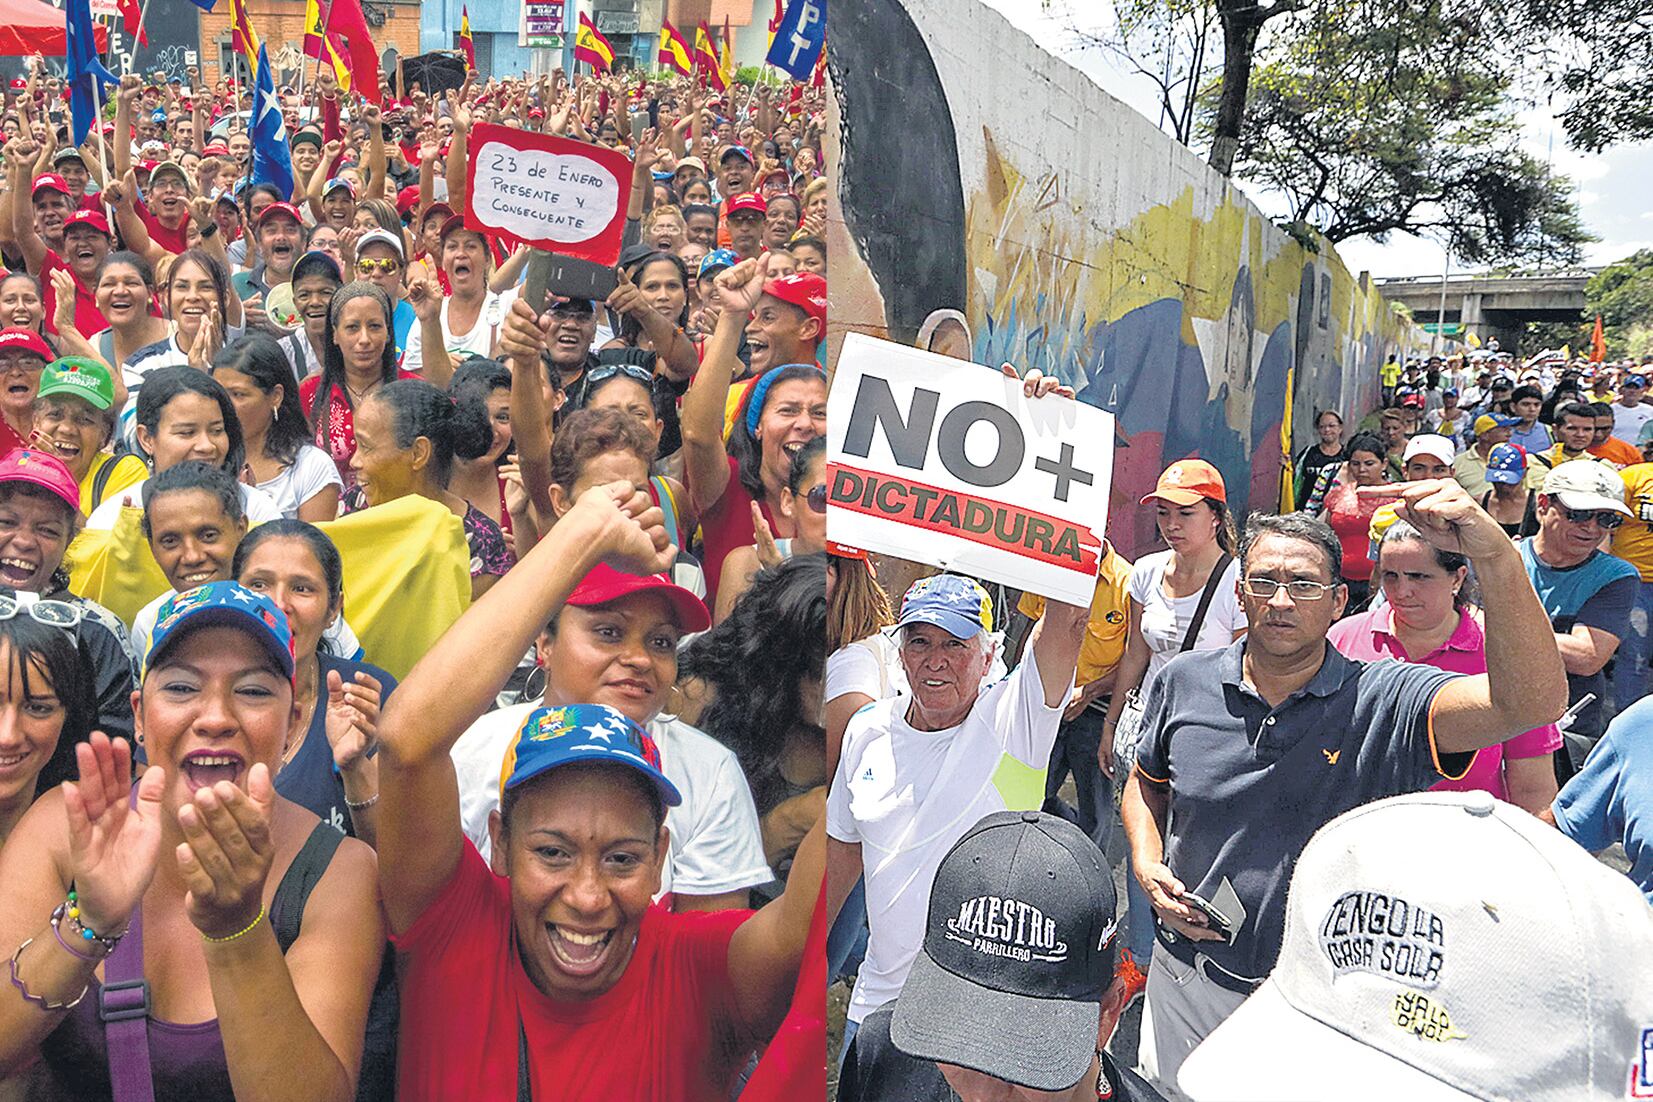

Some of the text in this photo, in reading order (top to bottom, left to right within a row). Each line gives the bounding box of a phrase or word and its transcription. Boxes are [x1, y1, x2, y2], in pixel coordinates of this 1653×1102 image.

[491, 153, 603, 188] 23 de ENERO
[491, 176, 560, 203] PRESENTE
[491, 198, 584, 229] CONSECUENTE
[830, 469, 1082, 563] DICTADURA
[956, 896, 1057, 949] MAESTRO
[1323, 892, 1444, 947] TENGO LA
[973, 937, 1031, 962] PARRILLERO
[1327, 937, 1444, 982] CASA SOLA
